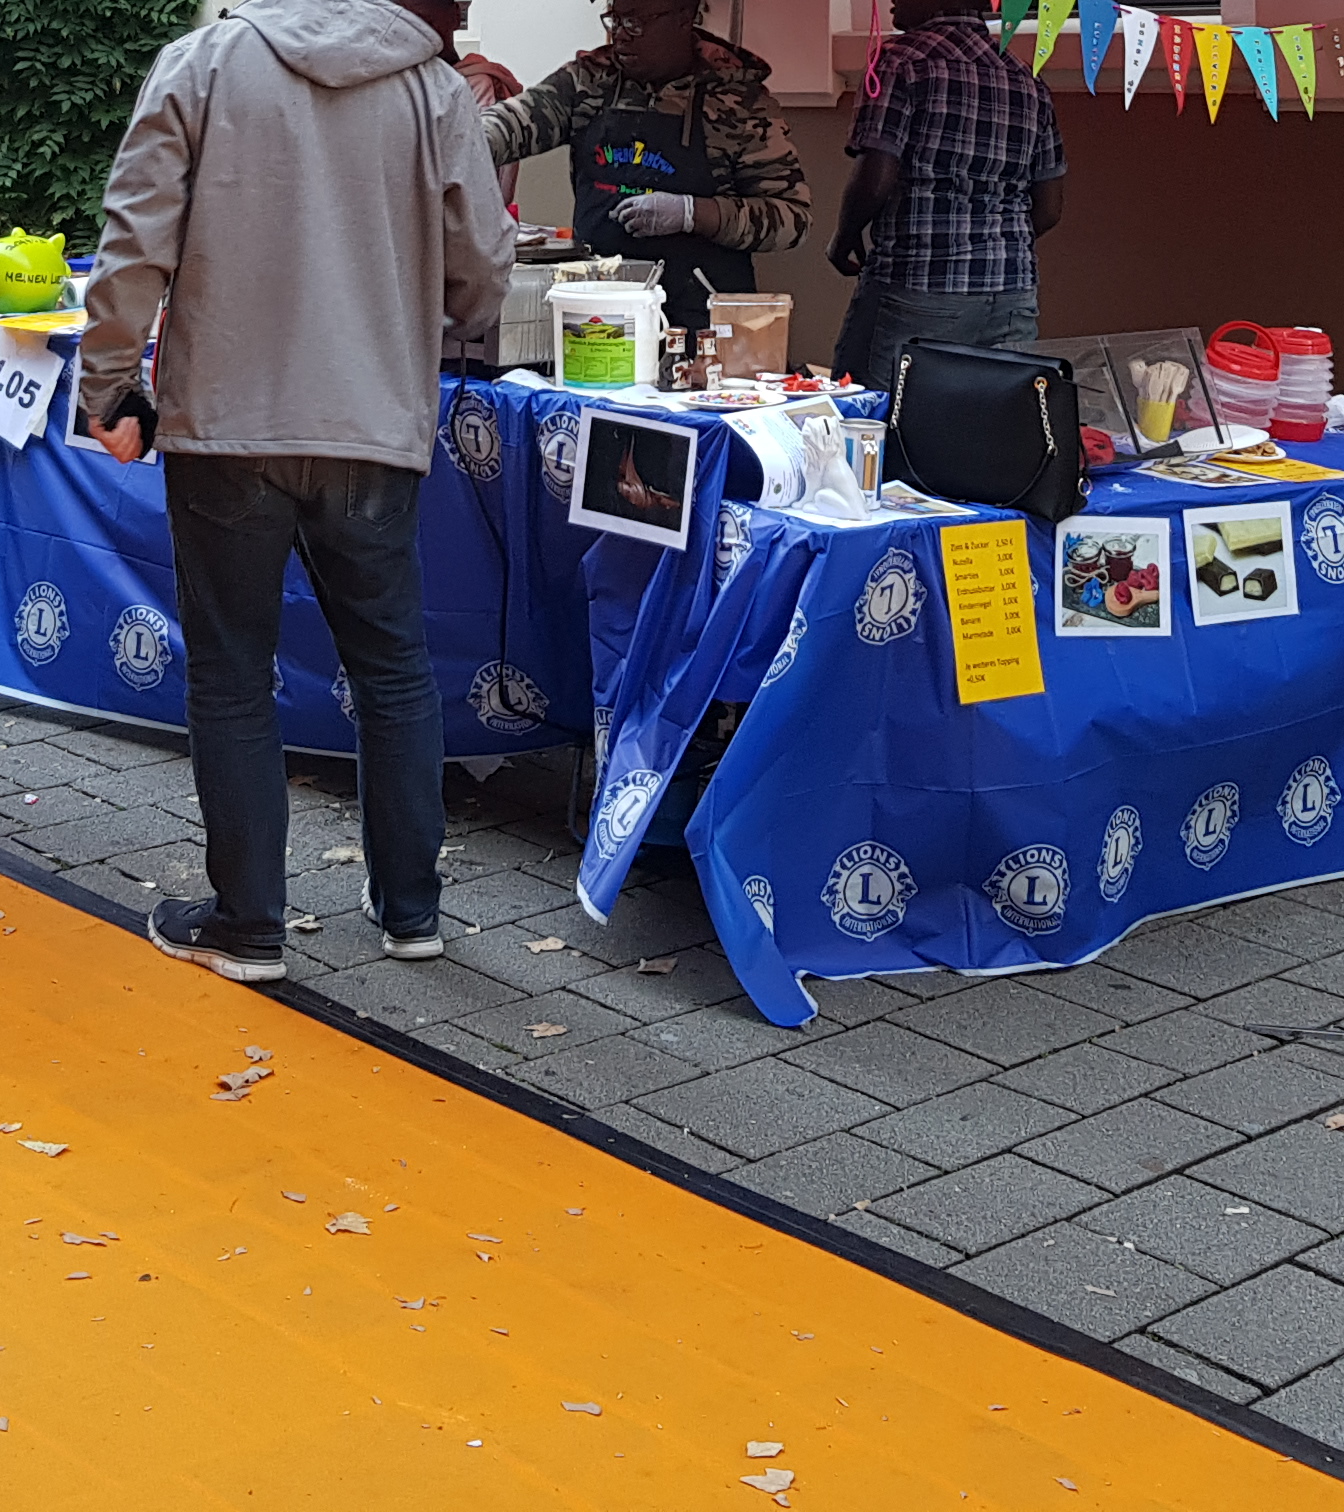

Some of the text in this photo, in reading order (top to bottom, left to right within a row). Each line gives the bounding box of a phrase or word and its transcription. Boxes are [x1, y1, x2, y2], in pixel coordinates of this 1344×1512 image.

[466, 423, 483, 454] L
[547, 415, 580, 435] LION
[555, 440, 571, 474] L
[720, 521, 733, 551] L
[1322, 525, 1341, 554] L
[28, 584, 63, 607] LIONS
[880, 582, 895, 615] L
[34, 607, 49, 638] L
[124, 607, 165, 632] LIONS
[862, 616, 910, 641] LIONS
[133, 631, 149, 662] L
[506, 684, 523, 707] L
[1293, 759, 1327, 783] LIONS
[1301, 782, 1316, 813] L
[617, 795, 641, 832] L
[1111, 809, 1136, 829] IONS
[1203, 807, 1218, 837] L
[842, 845, 900, 871] LIONS
[1008, 849, 1063, 871] LIONS
[1112, 836, 1124, 870] L
[858, 872, 882, 906] L
[1022, 875, 1049, 906] L
